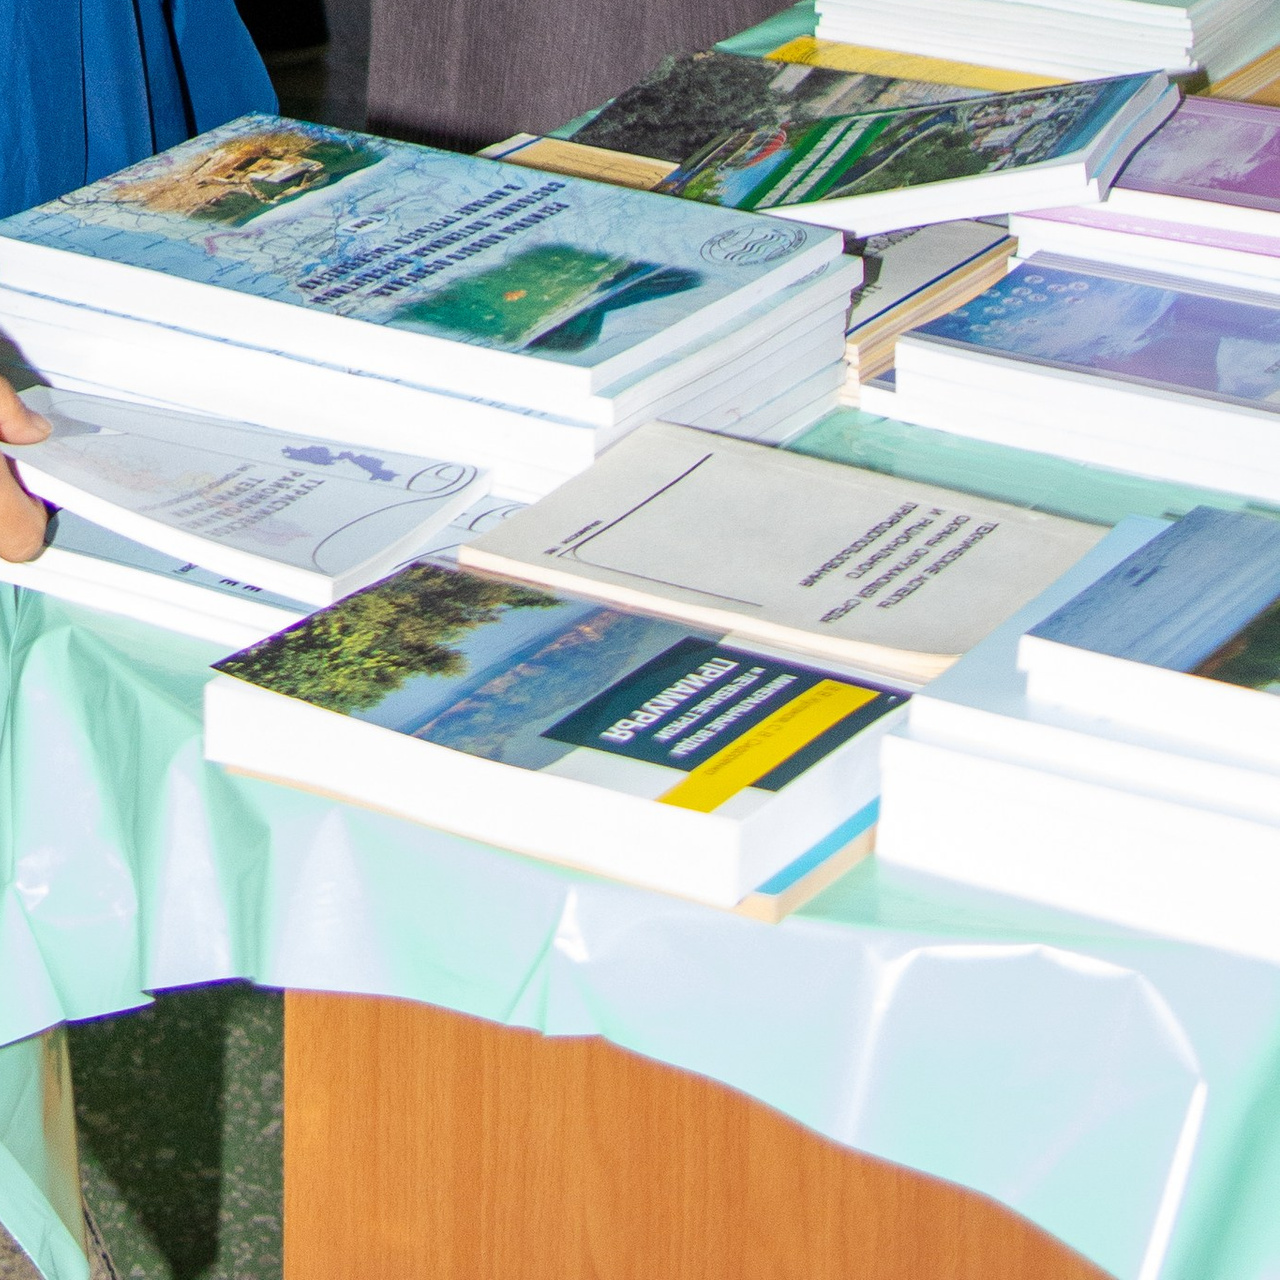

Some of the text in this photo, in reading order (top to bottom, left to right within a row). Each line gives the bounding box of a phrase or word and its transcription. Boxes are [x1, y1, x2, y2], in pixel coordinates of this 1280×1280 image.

[799, 502, 919, 587] ПРИРОДОПОЛЬЗОВАНИЯ
[820, 515, 970, 622] ОХРАНЫ ОКРУЖАЮЩЕЙ СРЕДЫ
[846, 517, 934, 578] РАЦИОНАЛЬНОГО
[877, 522, 999, 608] ТЕХНИЧЕСКИЕ АСПЕКТЫ
[598, 655, 739, 742] ПРИАМУРЬЯ
[651, 711, 701, 740] ГРЯЗИ
[669, 672, 798, 756] МИНЕРАЛЬНЫЕ ВОДЫ
[689, 671, 760, 714] ЛЕЧЕБНЫЕ
